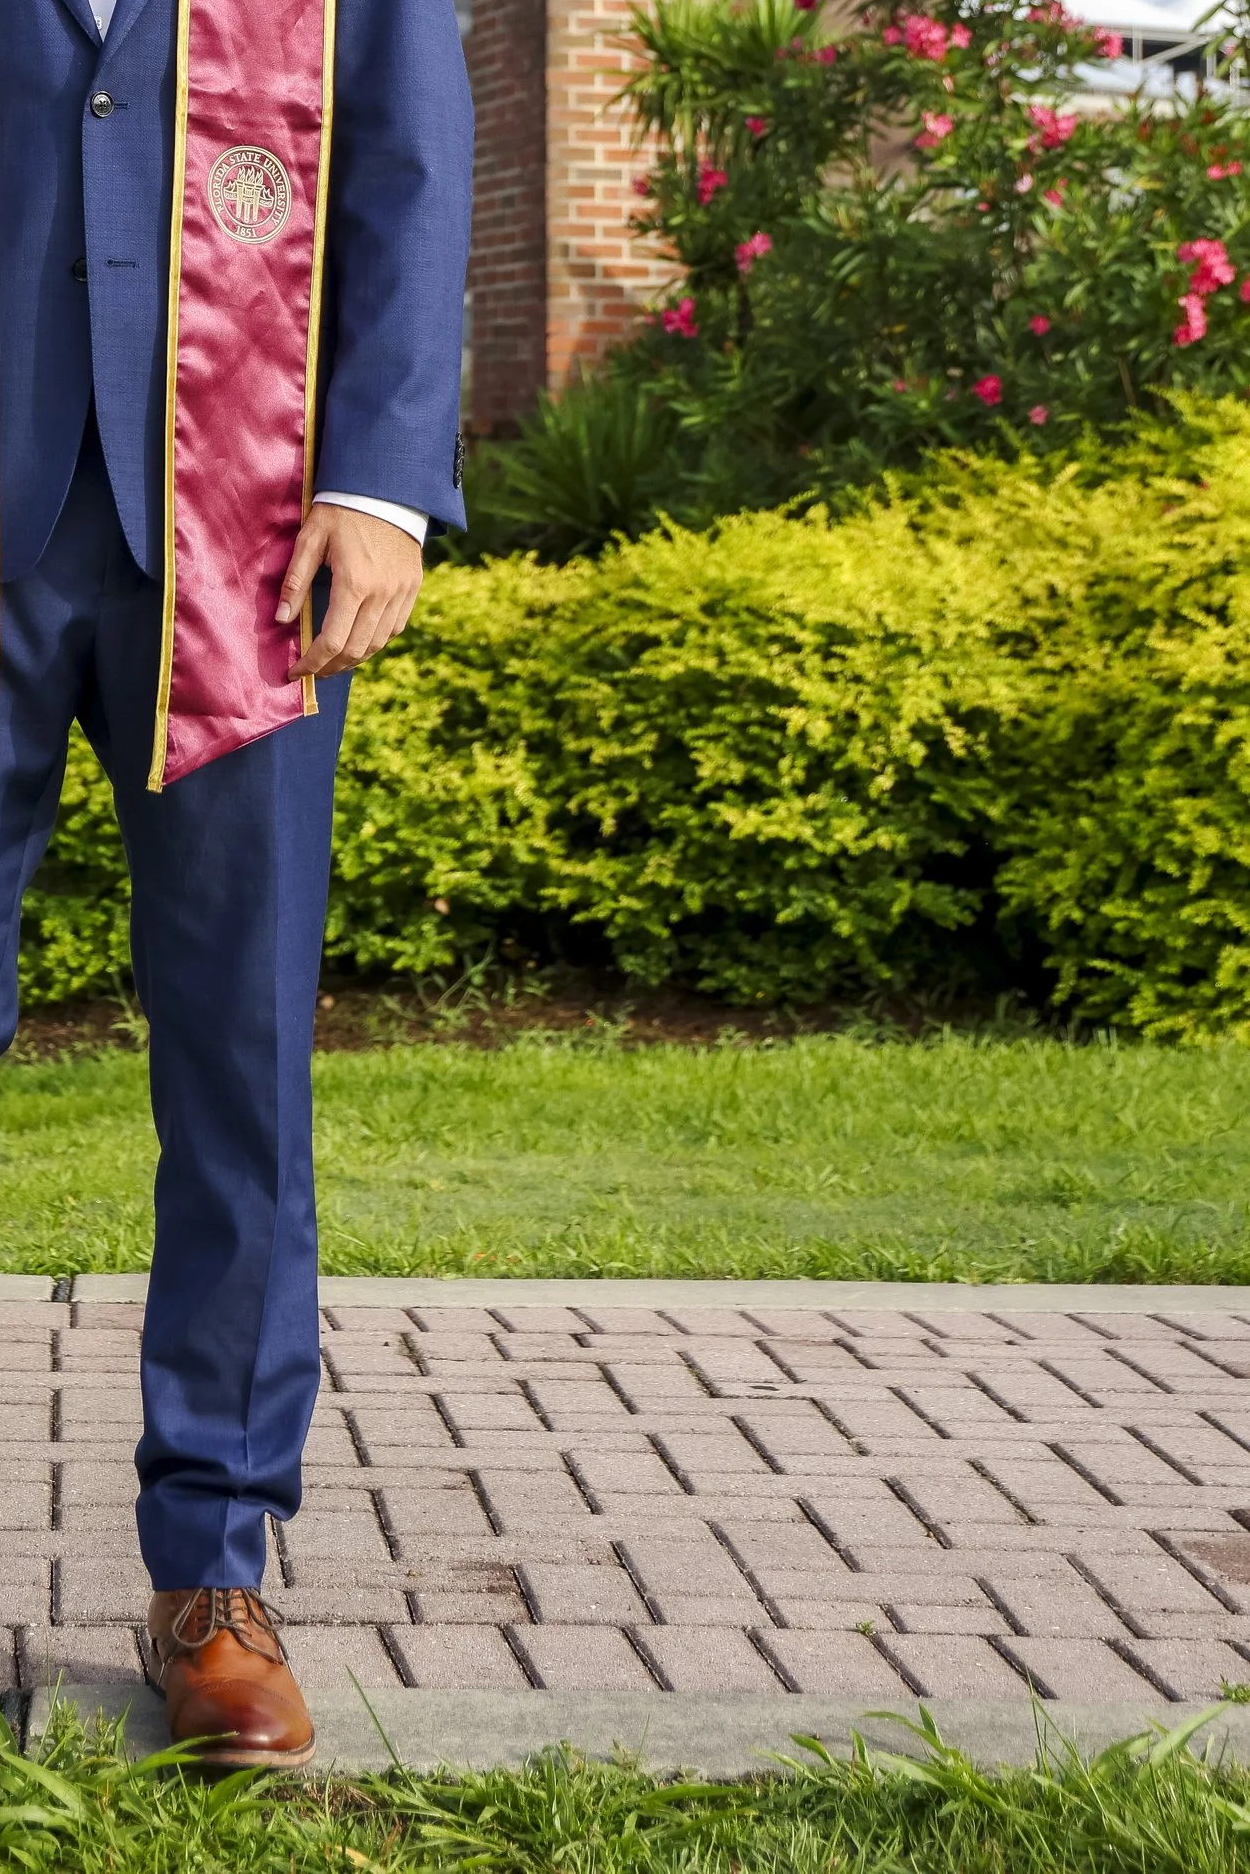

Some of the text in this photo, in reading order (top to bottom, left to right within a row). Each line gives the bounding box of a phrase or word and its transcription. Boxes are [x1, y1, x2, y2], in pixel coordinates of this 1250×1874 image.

[213, 152, 287, 226] FLORIDA STATE UNIVERSITY
[235, 225, 258, 238] 1851
